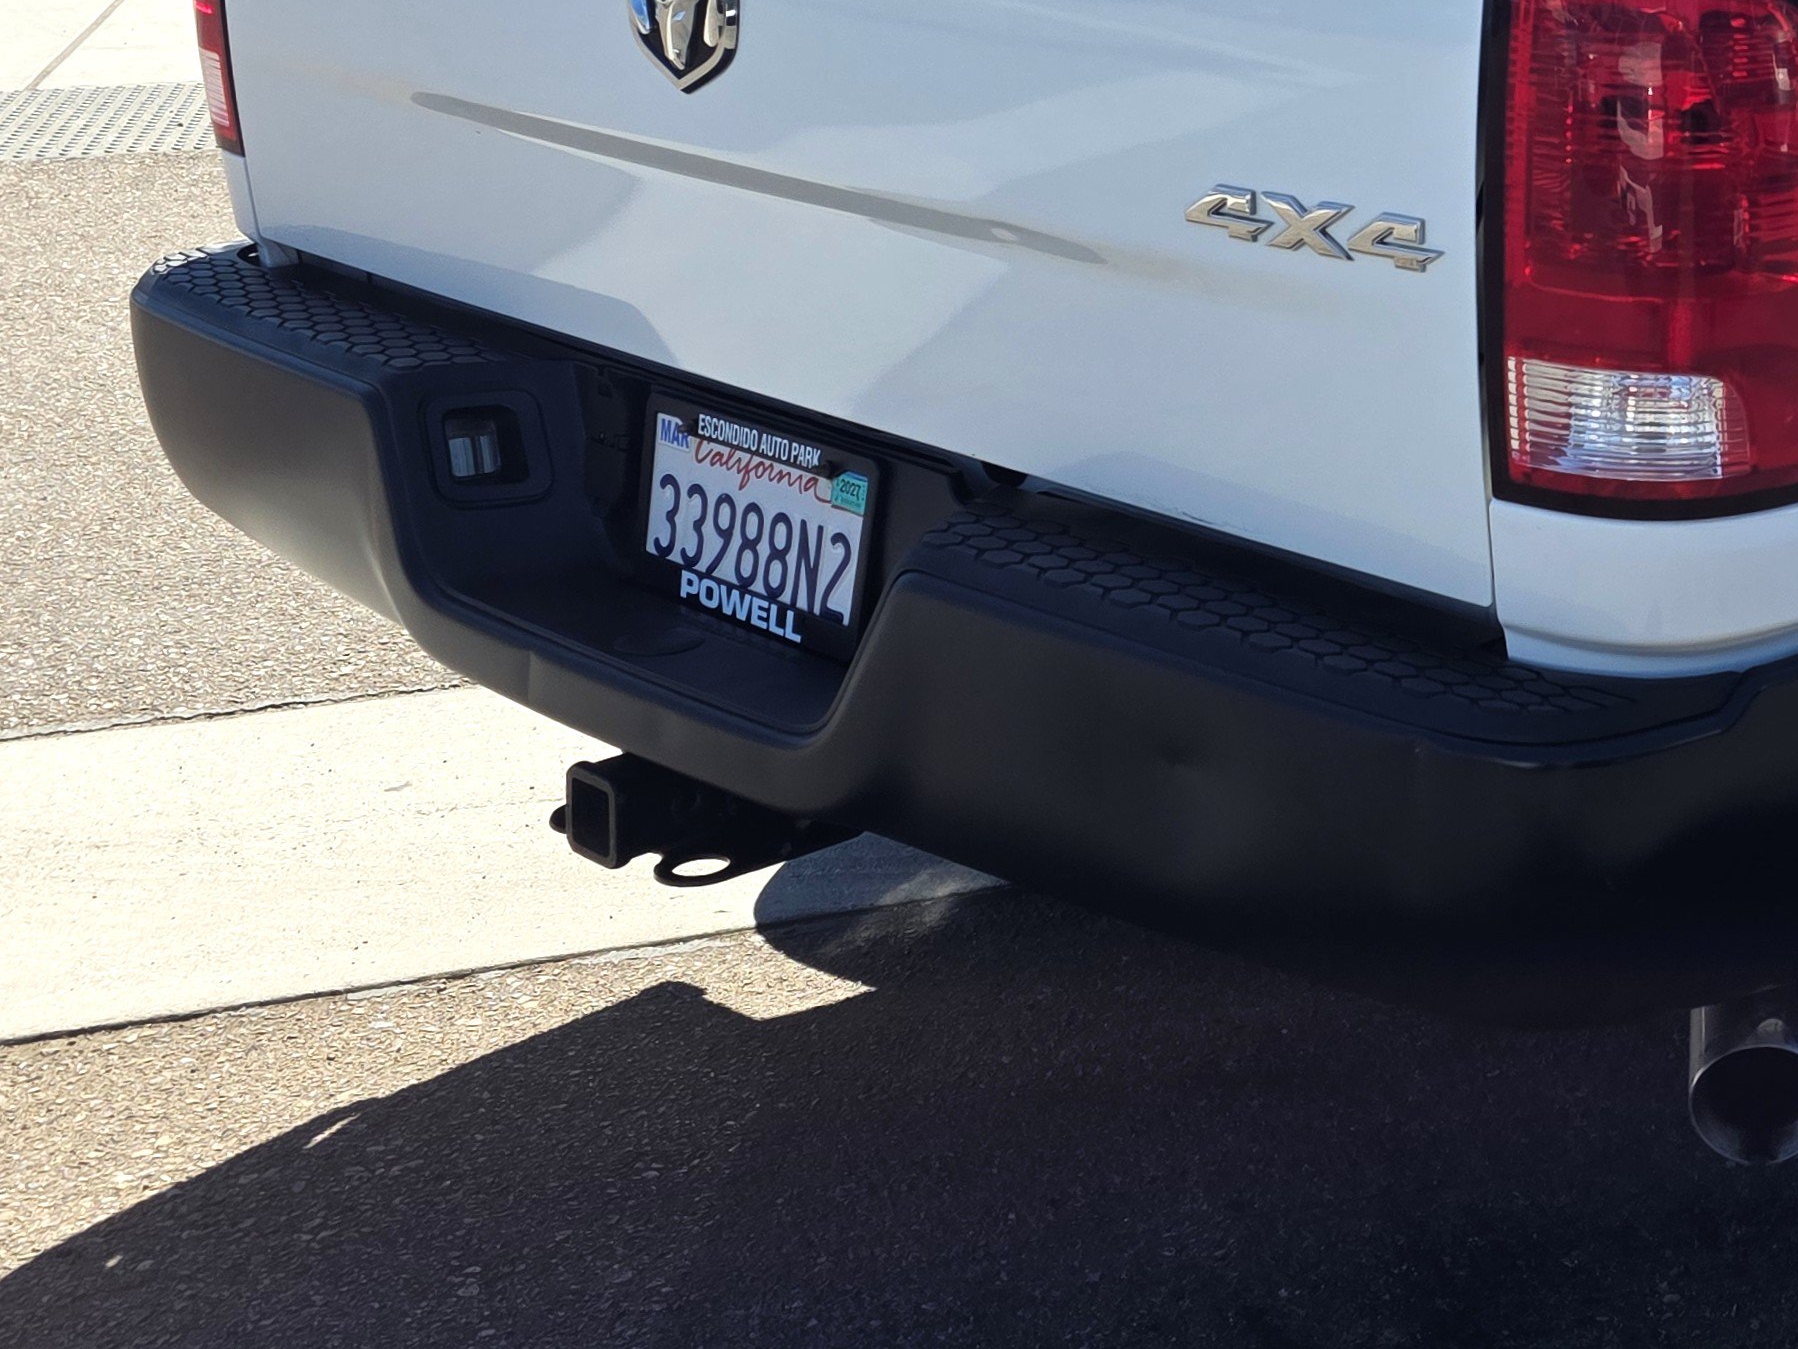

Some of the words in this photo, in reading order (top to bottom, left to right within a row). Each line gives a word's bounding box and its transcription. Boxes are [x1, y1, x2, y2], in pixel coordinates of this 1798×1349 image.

[694, 440, 832, 504] California
[698, 414, 758, 451] ESCONDIDO
[760, 433, 789, 460] AUTO
[789, 442, 822, 469] PARK
[840, 478, 861, 501] 2027
[654, 474, 852, 624] 33988N2
[680, 569, 802, 643] POWELL
